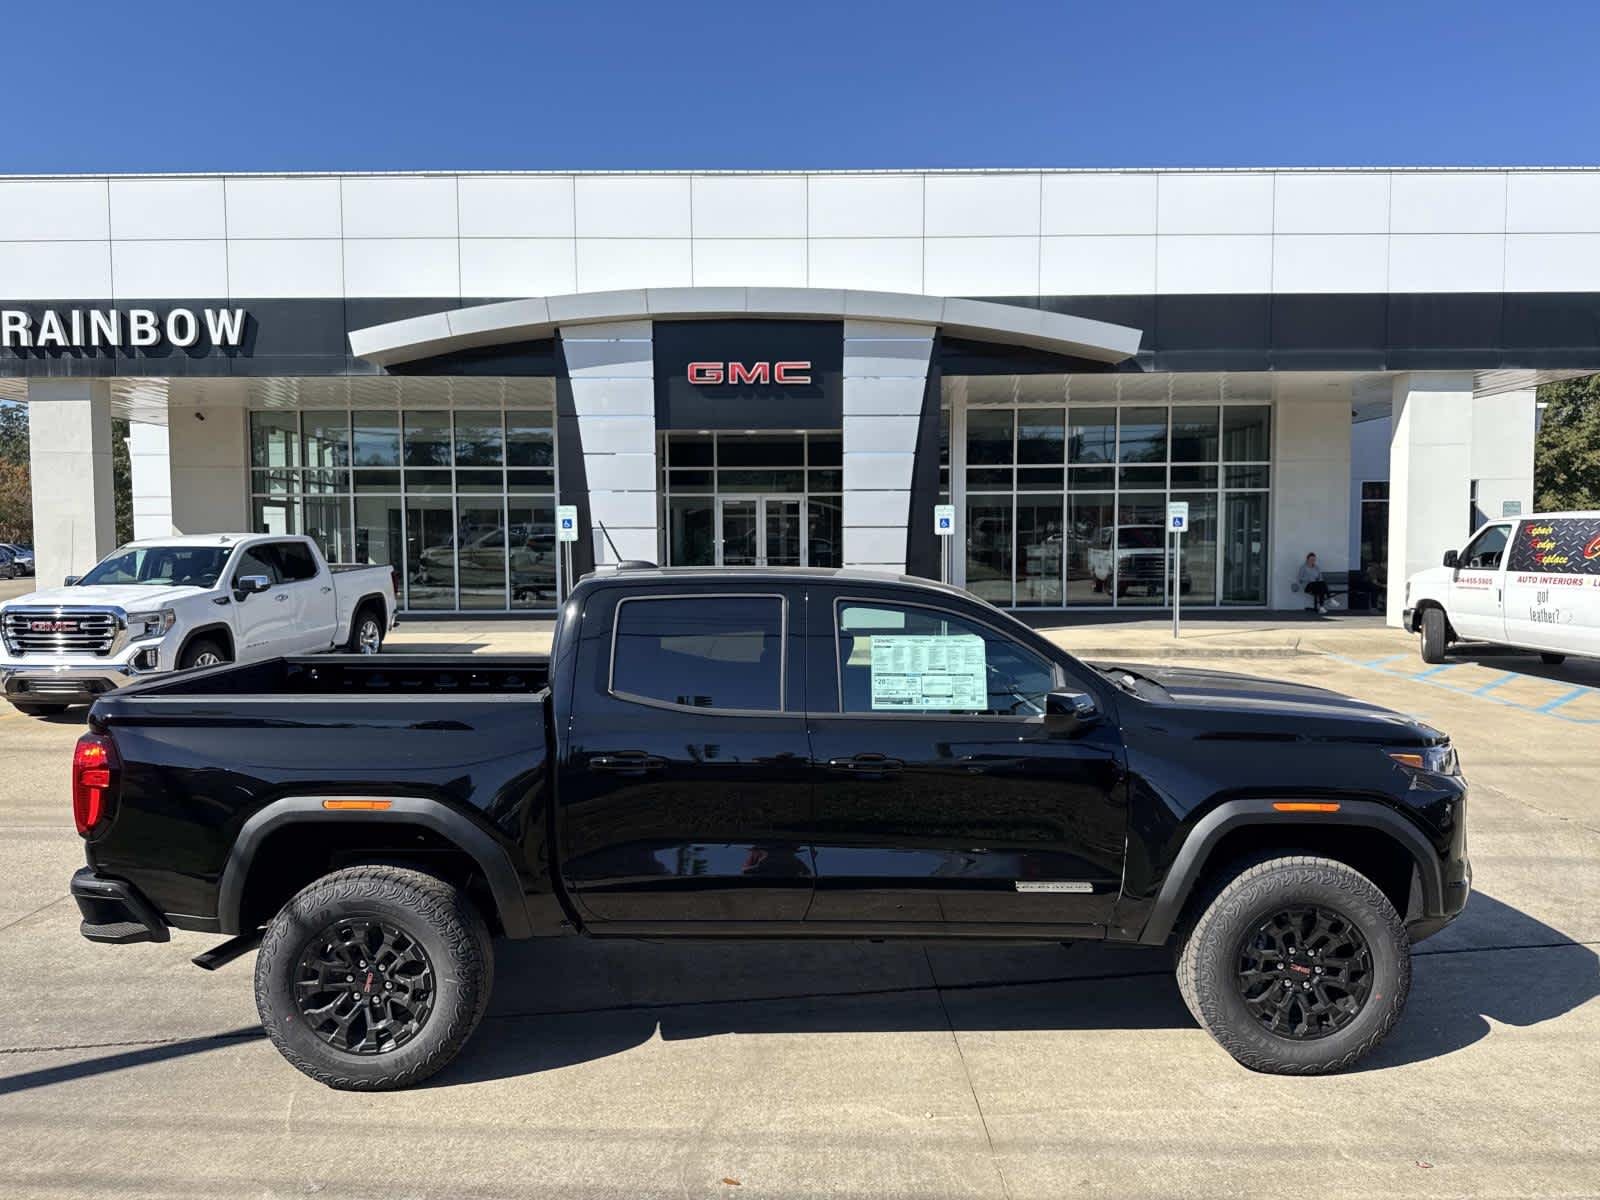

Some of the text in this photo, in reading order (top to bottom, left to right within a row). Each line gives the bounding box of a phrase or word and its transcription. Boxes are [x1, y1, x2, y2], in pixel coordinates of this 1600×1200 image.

[2, 308, 246, 348] RAINBOW
[687, 361, 812, 384] GMC
[1517, 576, 1538, 584] AUTO
[1540, 576, 1584, 586] INTERIORS
[1537, 588, 1549, 606] got
[1529, 607, 1560, 624] leather?
[31, 621, 78, 632] GMC
